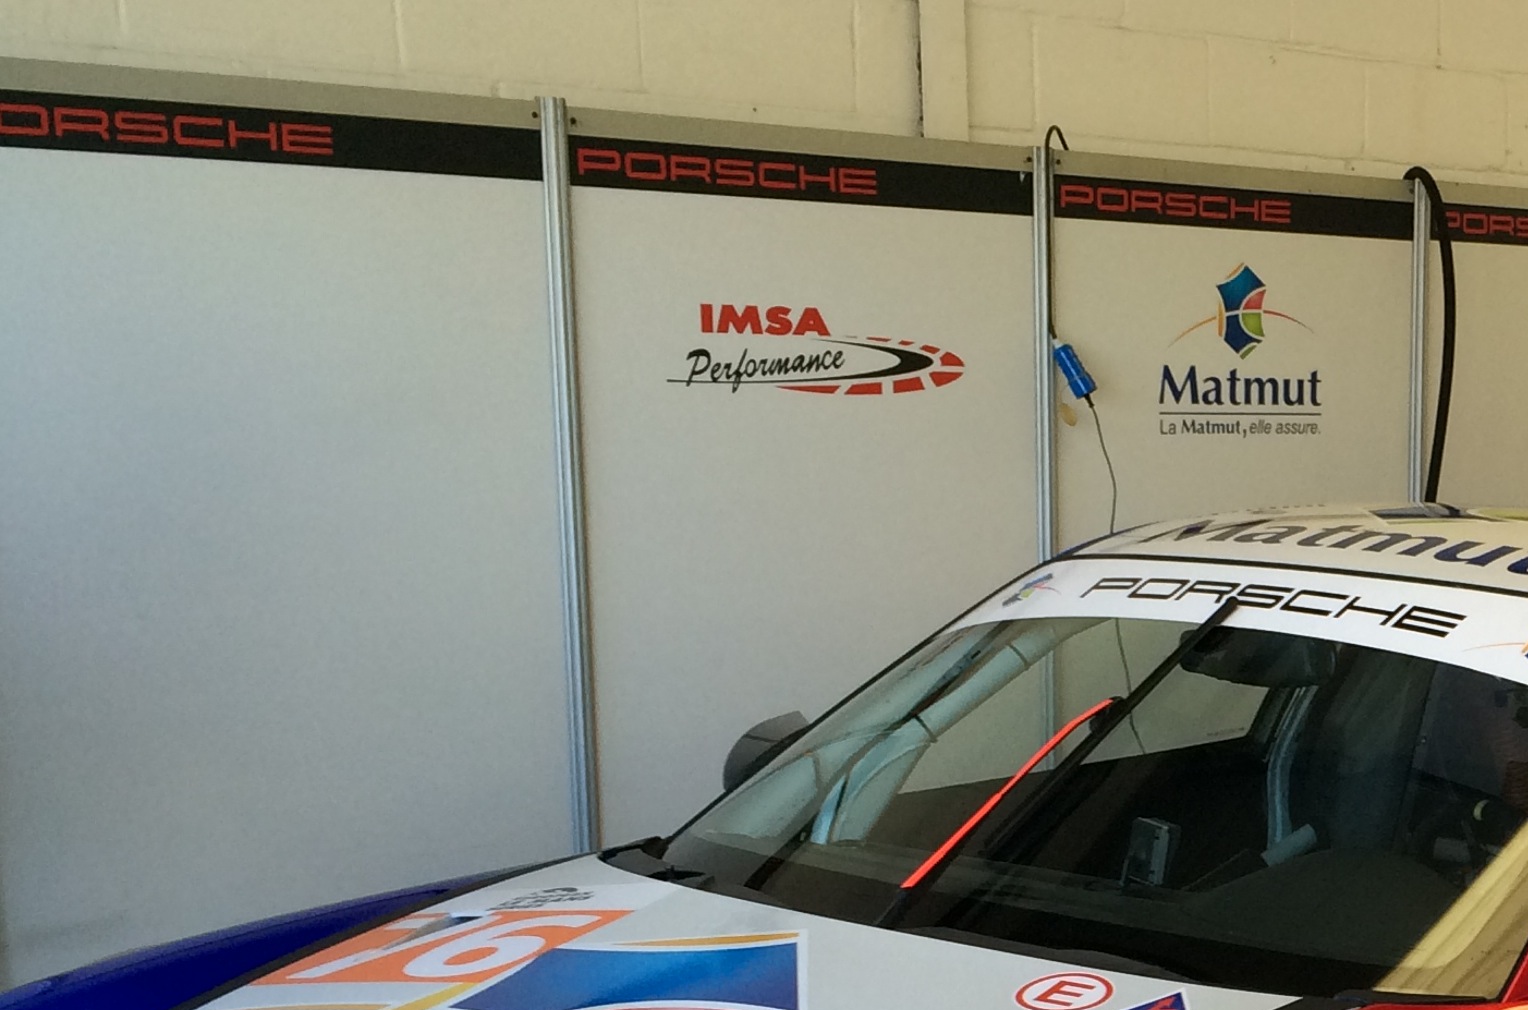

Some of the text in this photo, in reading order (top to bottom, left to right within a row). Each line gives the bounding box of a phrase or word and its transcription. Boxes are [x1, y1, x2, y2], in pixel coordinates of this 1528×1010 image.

[0, 103, 334, 156] ORSCHE
[577, 147, 877, 196] PORSCHE
[1059, 184, 1292, 225] PORSCHE
[700, 303, 831, 337] IMSA
[685, 346, 845, 394] Performance
[1158, 364, 1323, 408] Matmut
[1159, 419, 1177, 435] La
[1249, 418, 1272, 435] elle
[1079, 577, 1467, 638] PORSCHE
